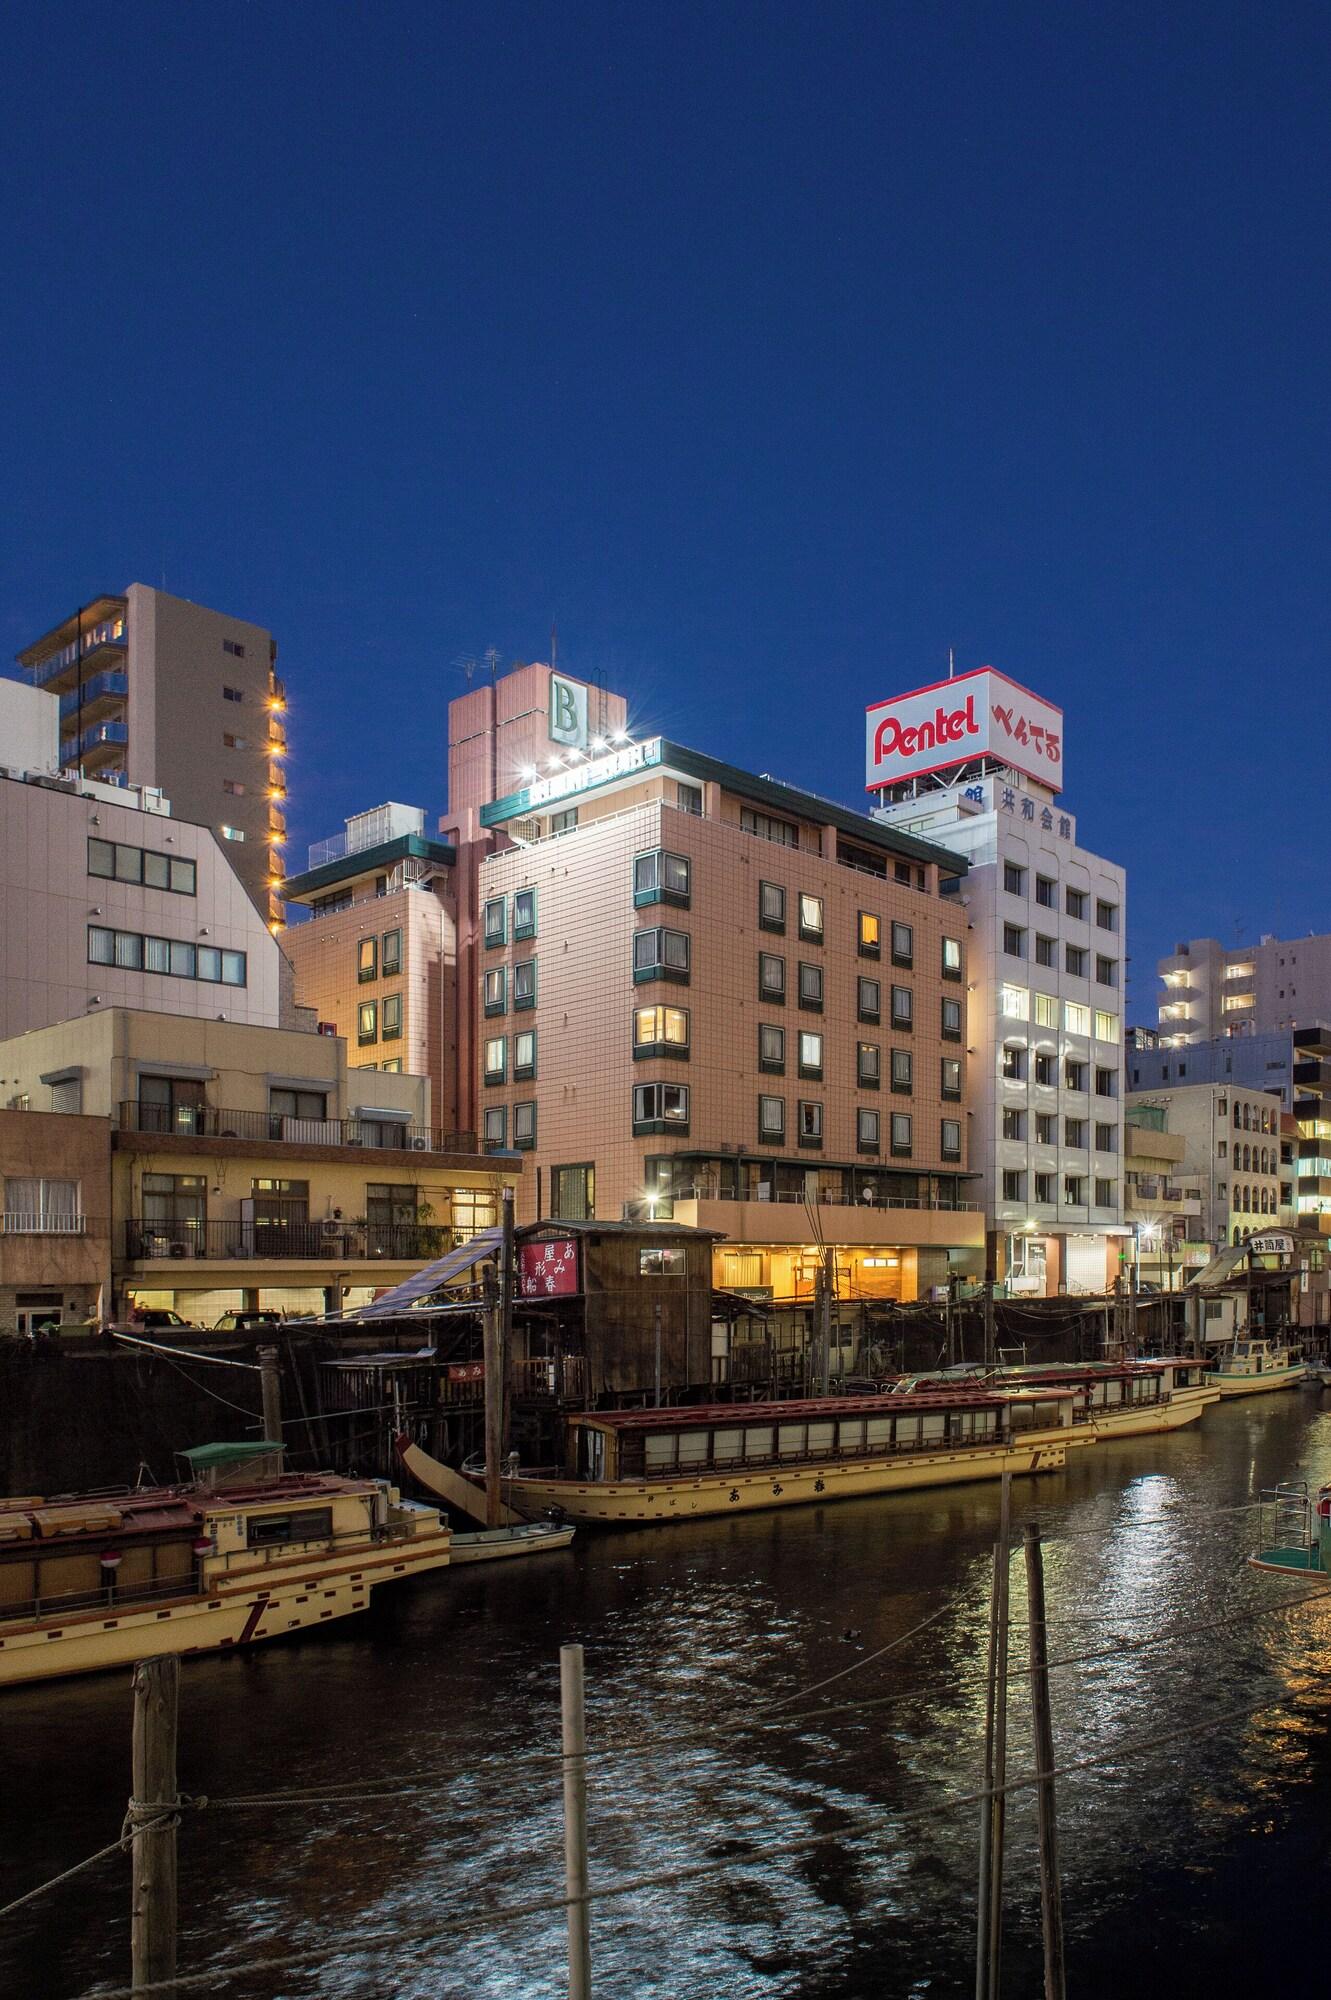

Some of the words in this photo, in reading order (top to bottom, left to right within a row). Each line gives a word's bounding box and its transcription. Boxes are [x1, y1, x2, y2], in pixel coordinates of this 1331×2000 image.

[554, 681, 578, 732] B
[874, 695, 979, 766] Pentel
[1001, 787, 1071, 840] 共和会館
[1254, 1239, 1285, 1251] 井筒屋
